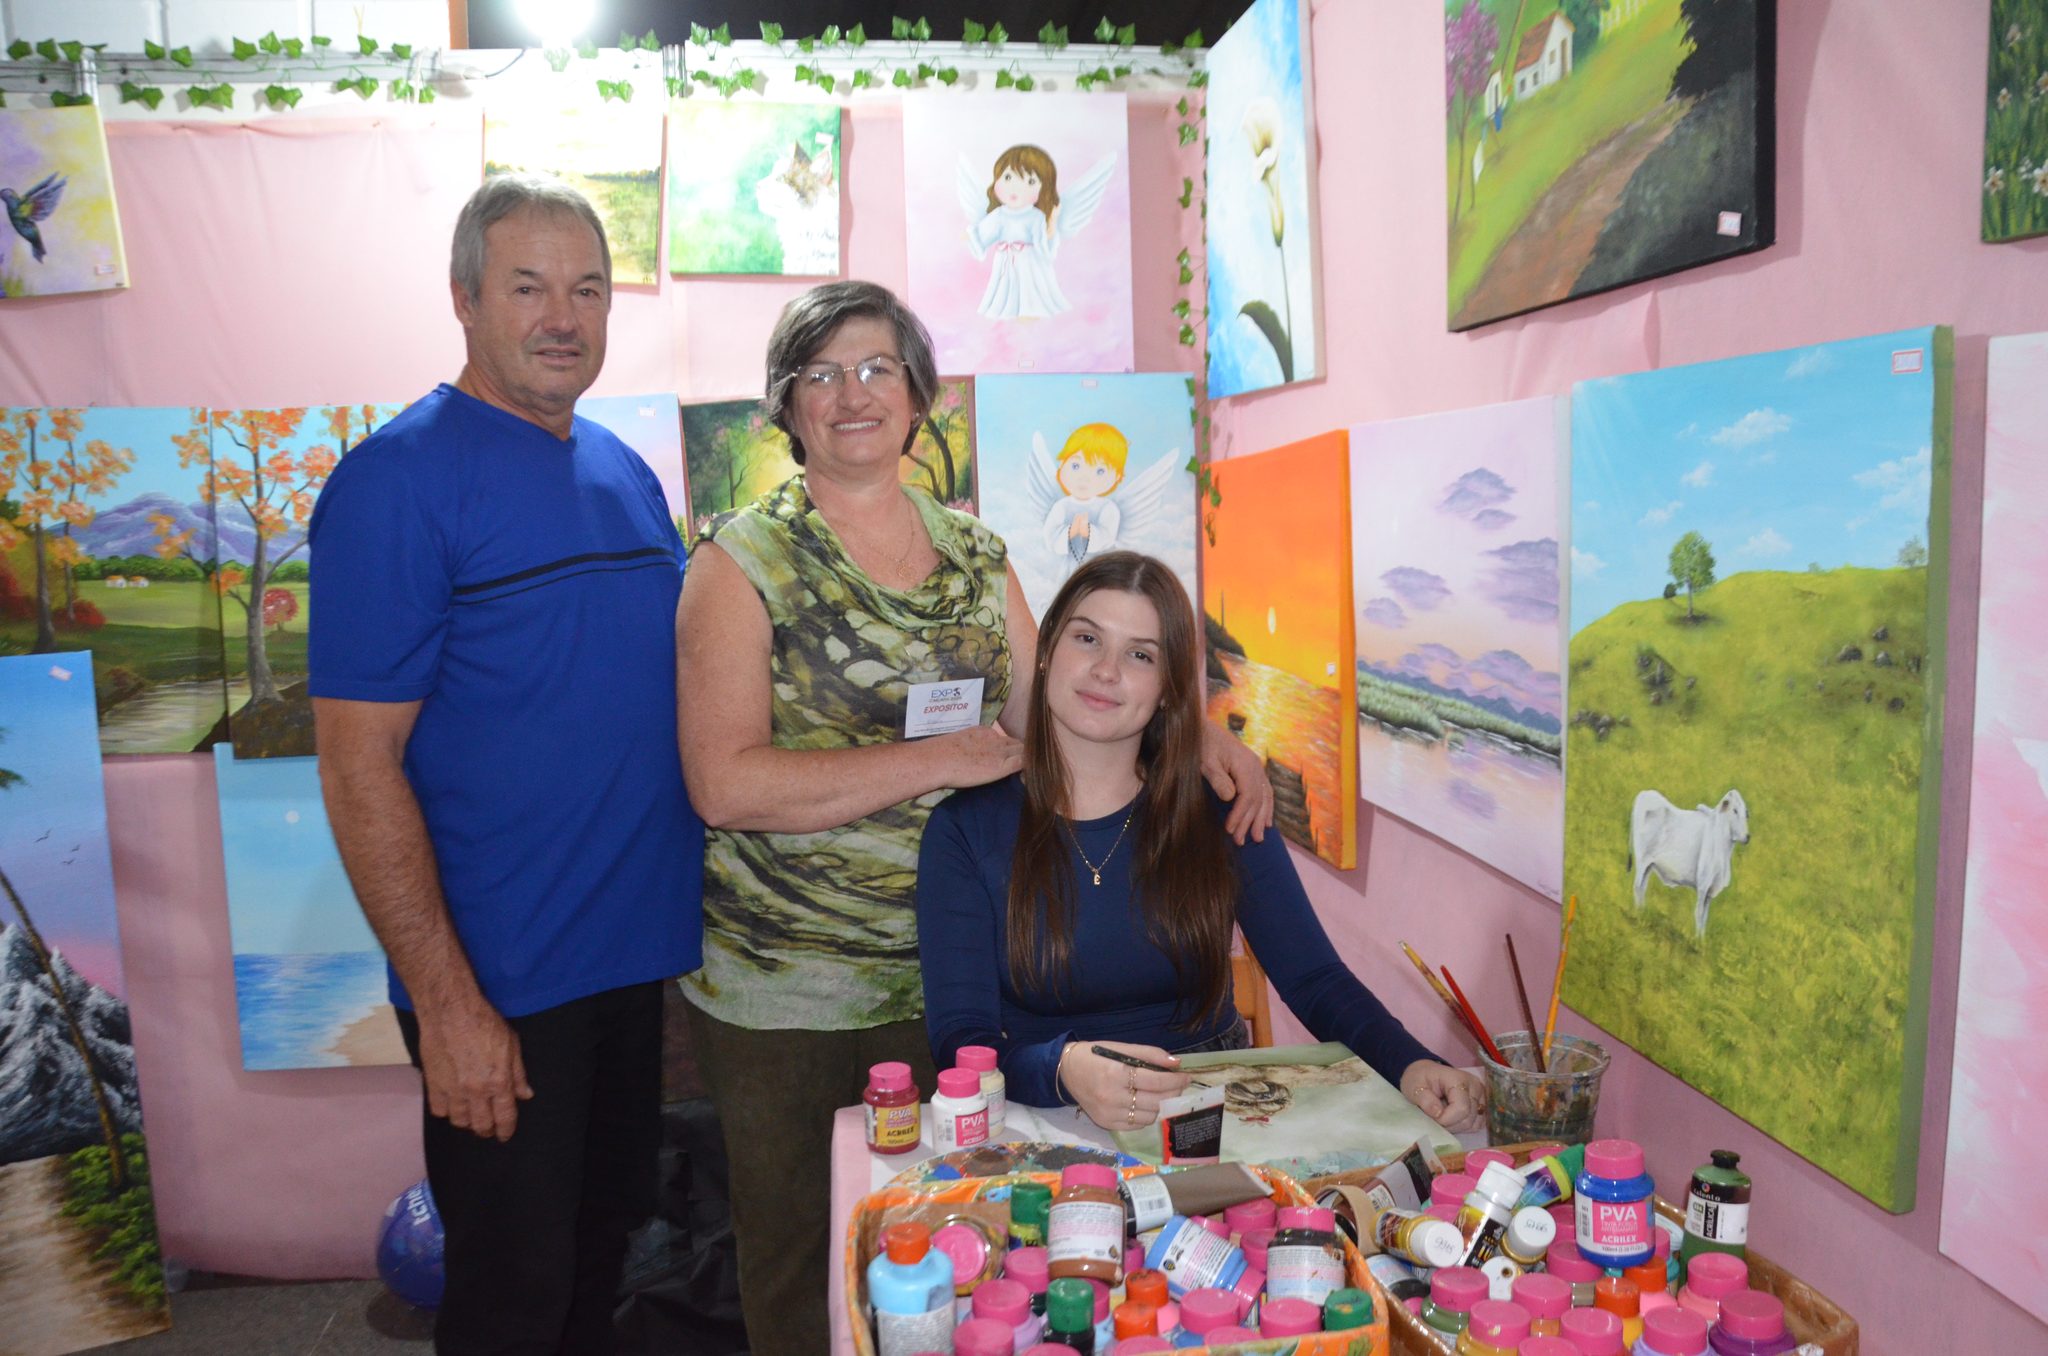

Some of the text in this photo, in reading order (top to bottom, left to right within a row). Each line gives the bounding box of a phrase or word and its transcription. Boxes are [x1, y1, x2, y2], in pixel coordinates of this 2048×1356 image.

[923, 702, 969, 714] EXPOSITOR
[889, 1109, 913, 1119] PVA
[961, 1115, 985, 1129] PVA
[1600, 1205, 1638, 1221] PVA
